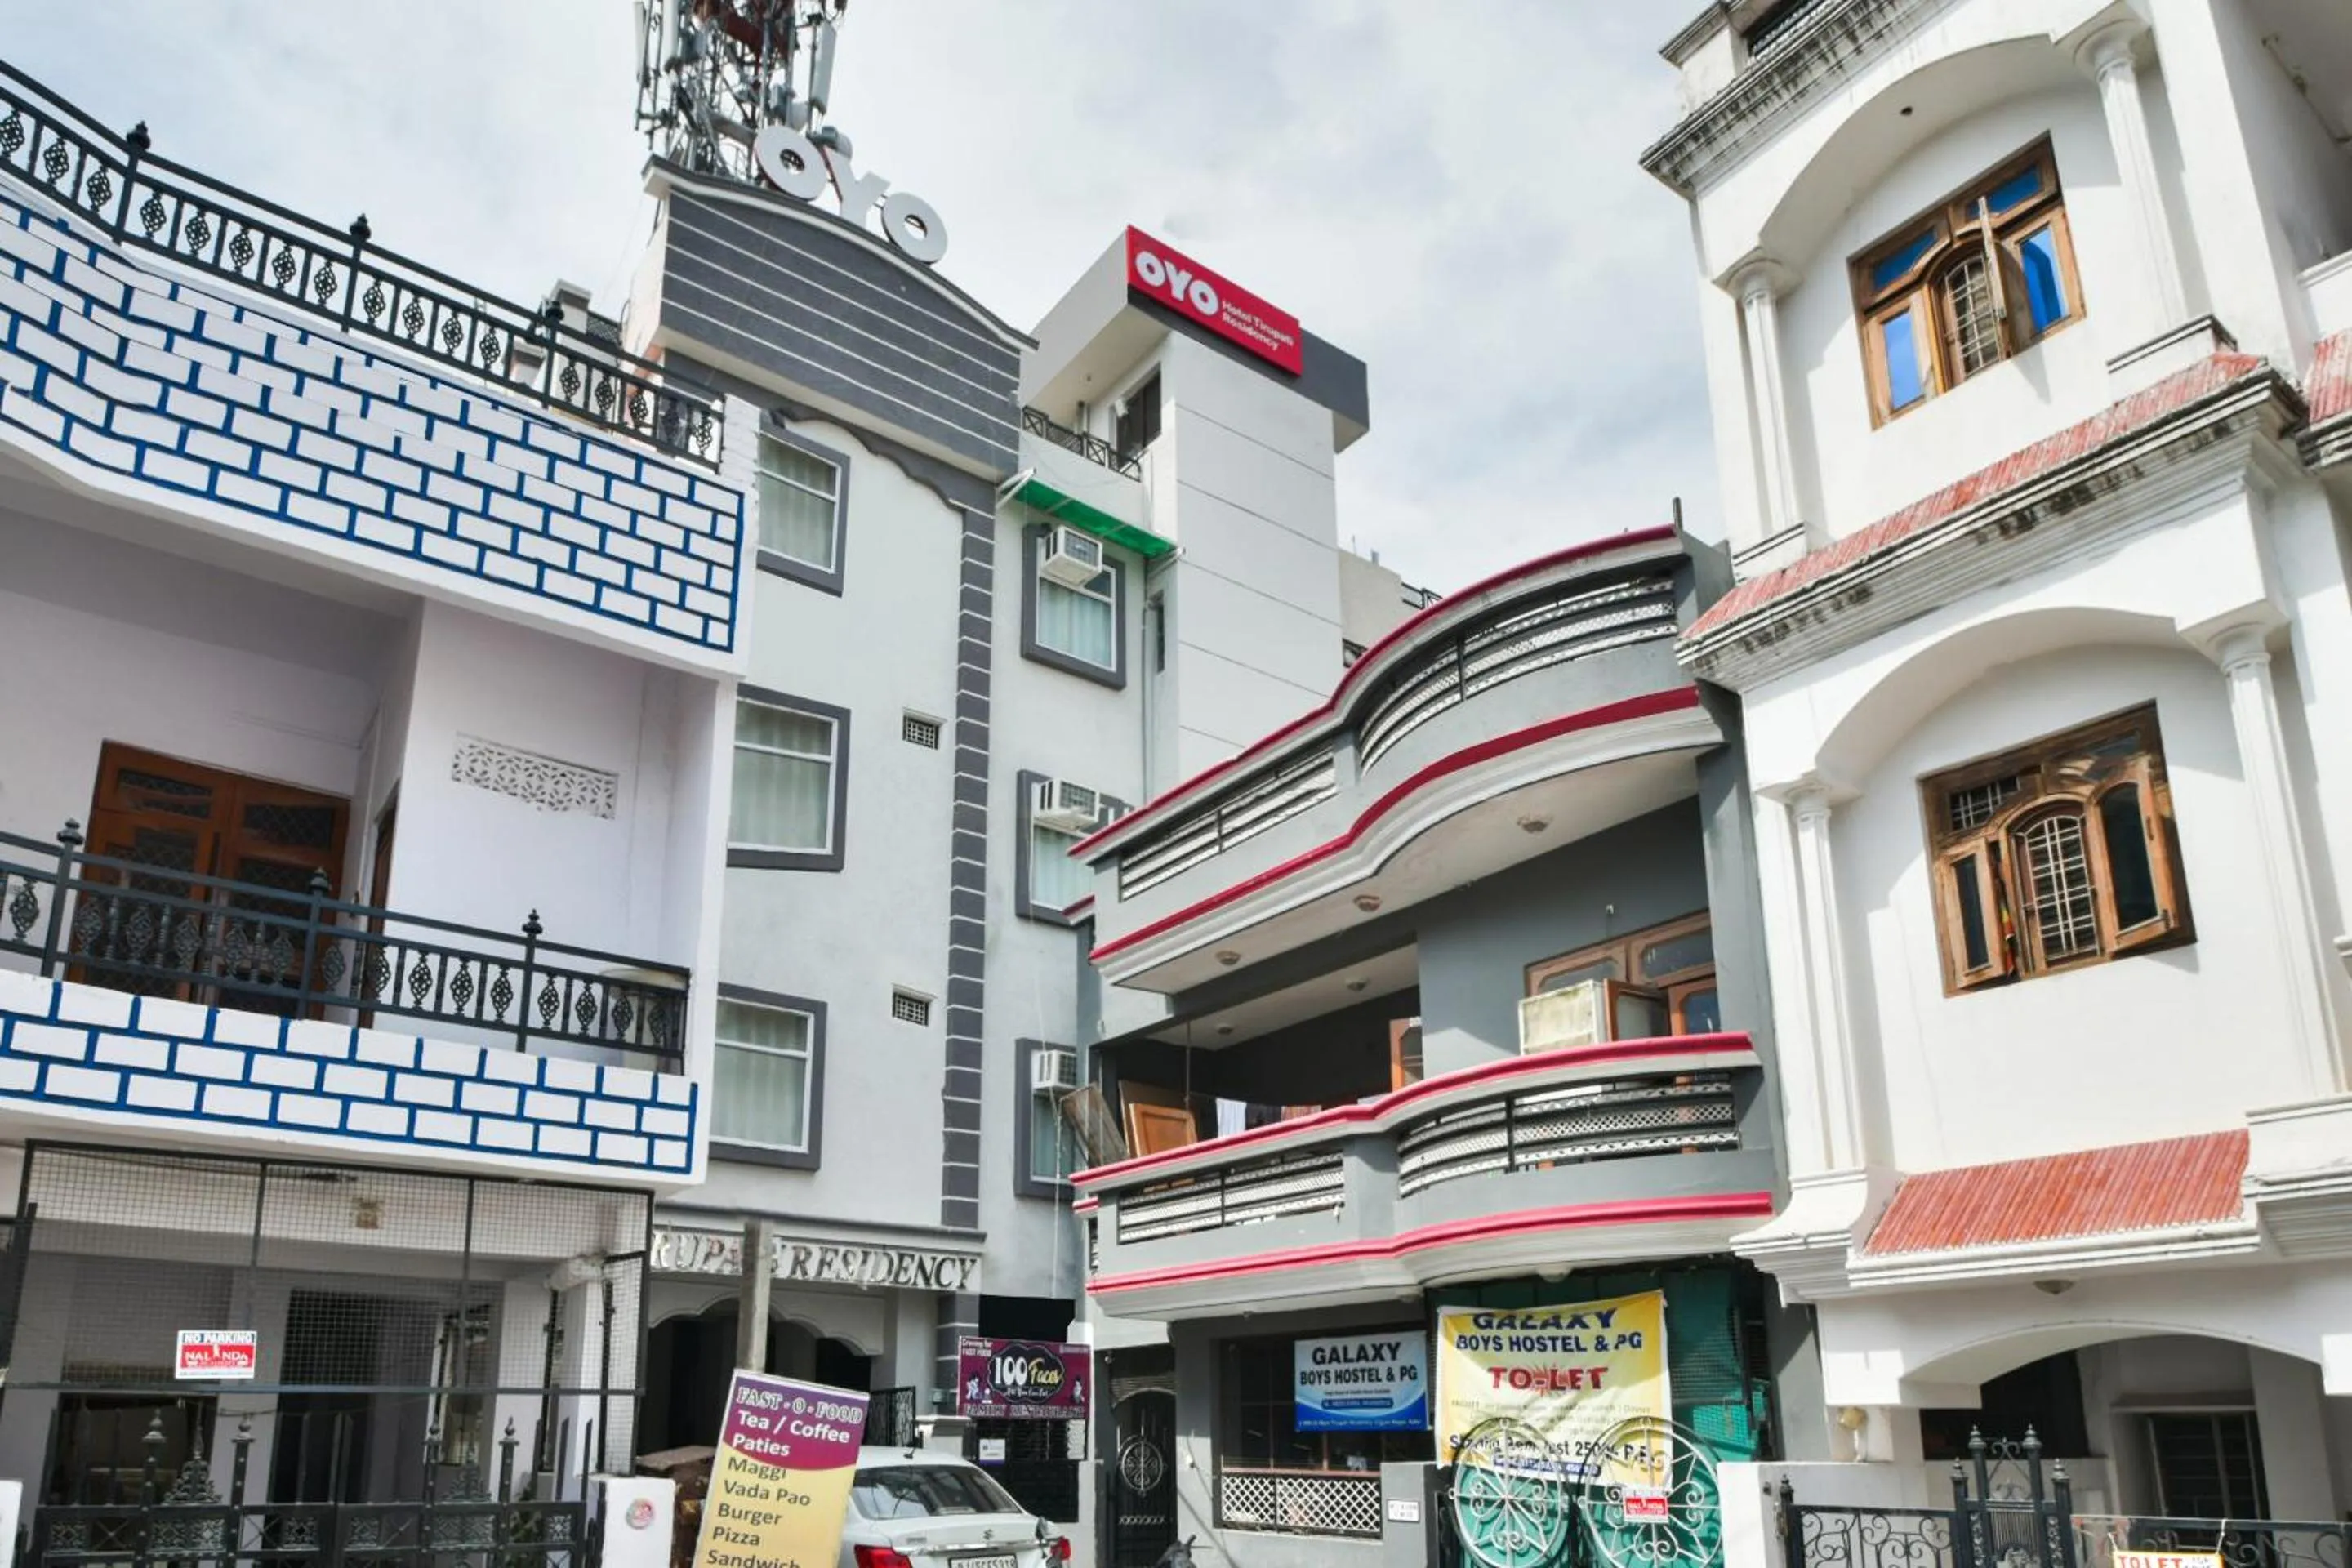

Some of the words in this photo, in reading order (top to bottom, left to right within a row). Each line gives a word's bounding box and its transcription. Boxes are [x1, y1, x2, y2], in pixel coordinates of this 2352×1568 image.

[753, 125, 948, 265] OYO
[1135, 250, 1219, 316] OYO
[790, 1245, 978, 1290] RESIDENCY
[1473, 1308, 1617, 1330] GALAXY
[1312, 1342, 1401, 1365] GALAXY
[1456, 1334, 1503, 1352] BOYS
[1508, 1334, 1588, 1352] HOSTEL
[1594, 1335, 1609, 1352] &
[1614, 1332, 1642, 1350] PG
[995, 1356, 1027, 1386] 100
[1300, 1370, 1330, 1386] BOYS
[1334, 1368, 1382, 1384] HOSTEL
[1386, 1366, 1396, 1383] &
[1400, 1365, 1418, 1381] PG
[1488, 1366, 1609, 1391] TO-LET
[738, 1410, 770, 1430] Tea
[773, 1415, 786, 1435] /
[790, 1419, 850, 1444] Coffee
[732, 1432, 791, 1457] Paties
[728, 1457, 786, 1481] Maggi
[724, 1479, 770, 1500] Vada
[777, 1488, 811, 1506] Pao
[718, 1503, 782, 1526] Burger
[713, 1526, 760, 1546] Pizza
